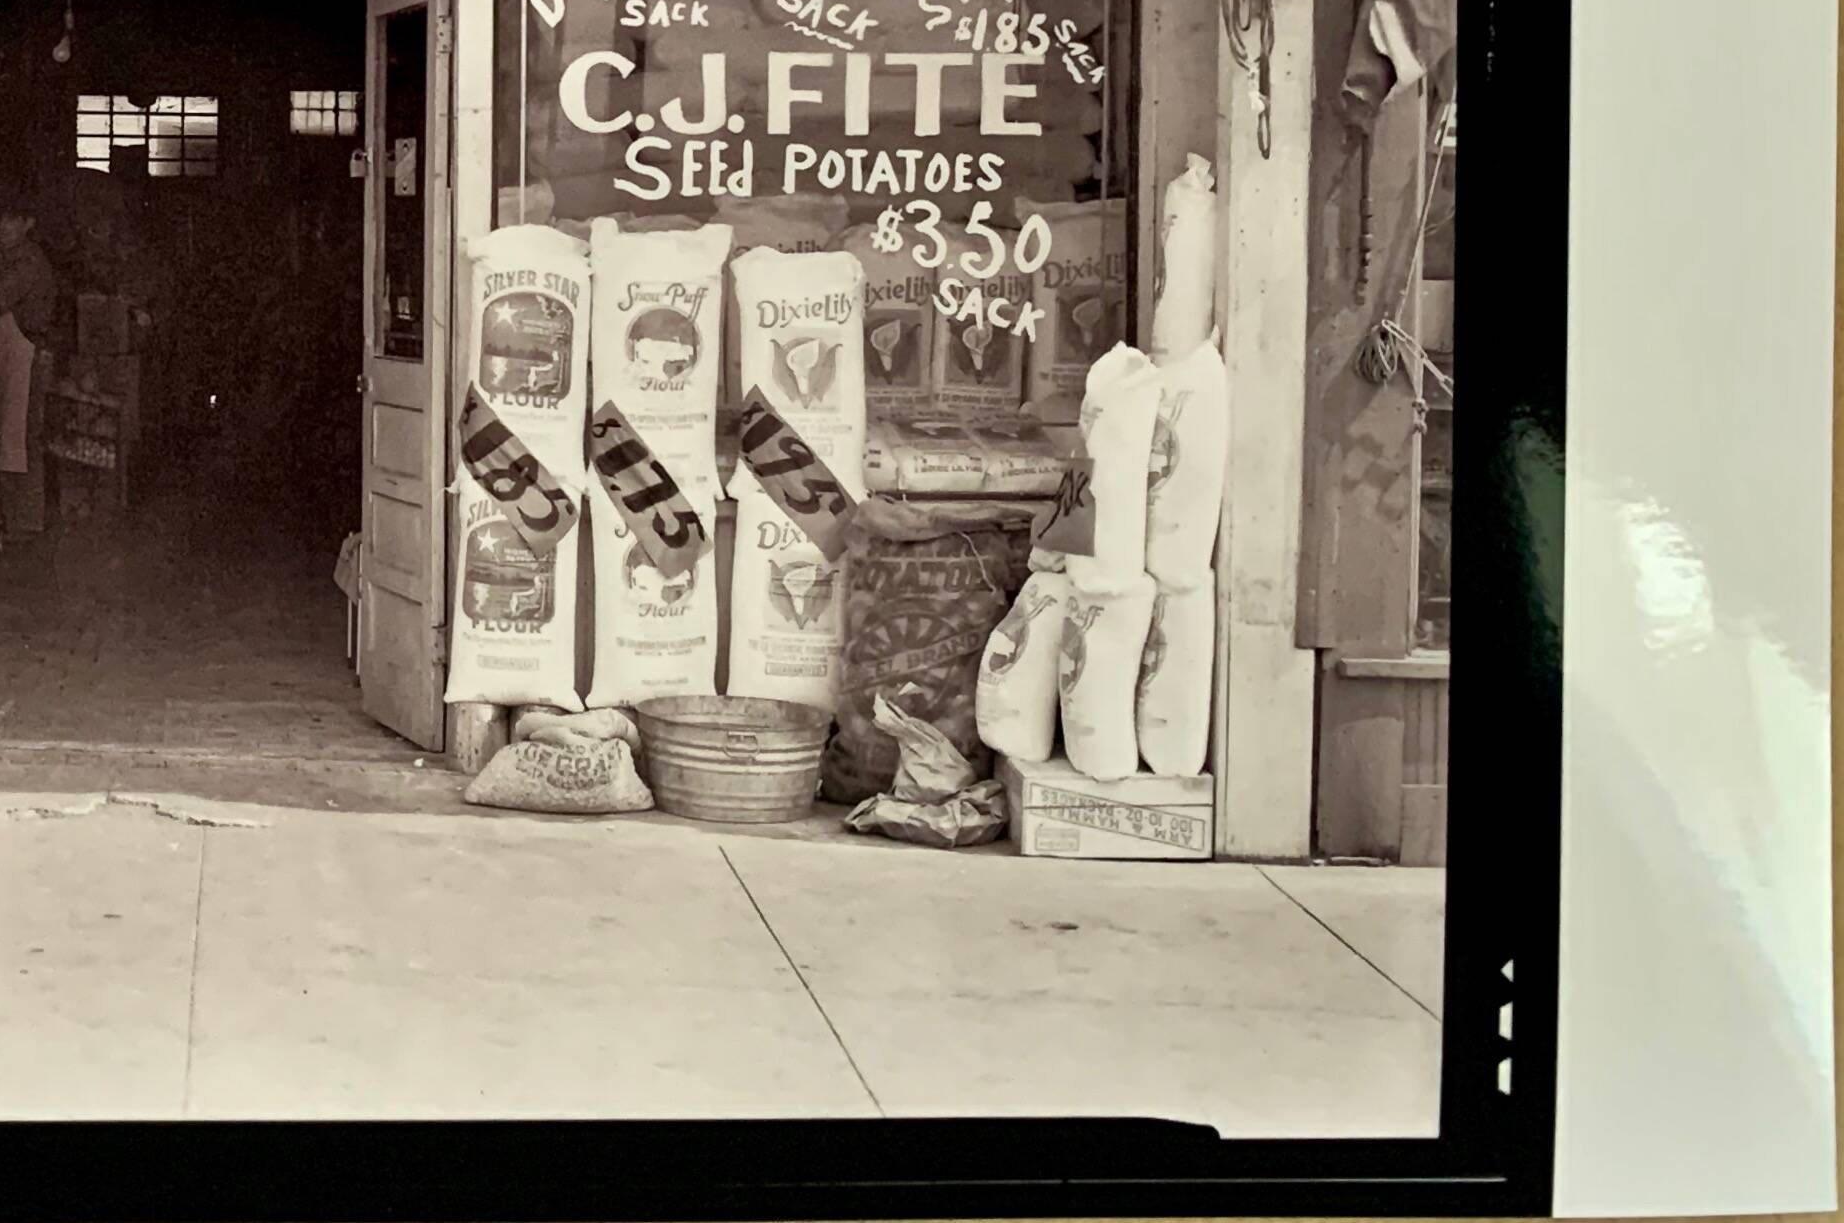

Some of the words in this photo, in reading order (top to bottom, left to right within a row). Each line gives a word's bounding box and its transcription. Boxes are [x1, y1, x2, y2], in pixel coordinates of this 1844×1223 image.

[768, 52, 1045, 136] FITE
[783, 144, 1003, 194] POTATOES
[483, 271, 537, 300] SILVER
[542, 271, 581, 309] STAR
[665, 284, 710, 320] Puff
[933, 278, 1046, 342] SACK
[640, 376, 692, 392] Flour
[489, 391, 560, 409] FLOUR
[638, 604, 690, 619] Flour
[472, 618, 543, 634] FLOUR
[1154, 828, 1193, 846] ARM
